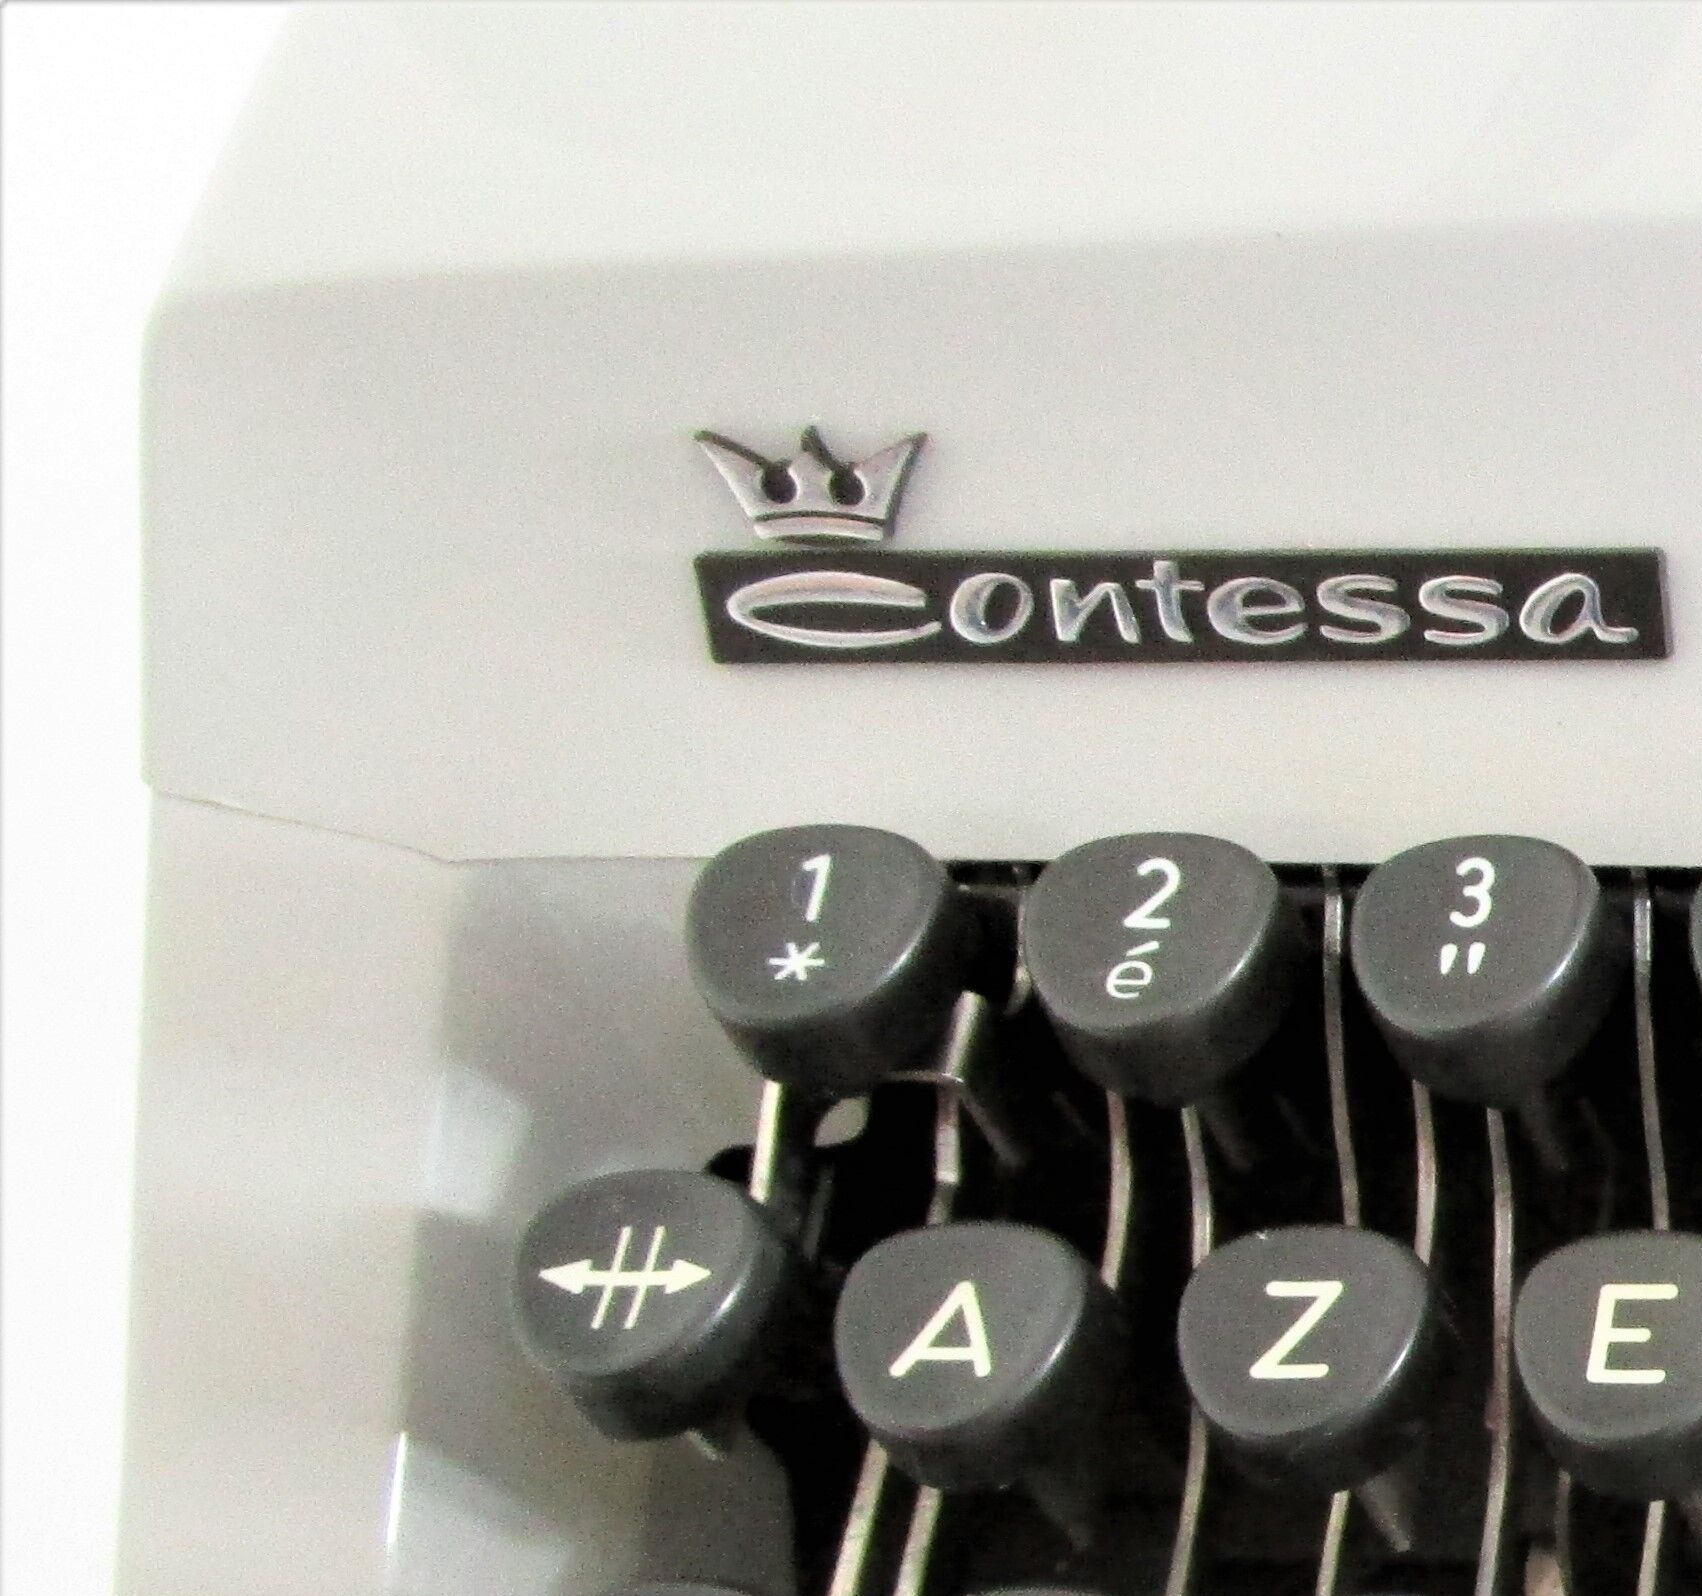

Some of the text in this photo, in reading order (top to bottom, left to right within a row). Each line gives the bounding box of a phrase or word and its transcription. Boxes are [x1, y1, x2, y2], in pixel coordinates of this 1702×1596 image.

[724, 558, 1638, 650] Contessa
[800, 851, 835, 925] 1
[1121, 854, 1183, 923] 2
[1447, 854, 1498, 922] 3
[1104, 938, 1163, 1001] é
[886, 1277, 996, 1380] A
[1247, 1278, 1347, 1382] Z
[1584, 1281, 1681, 1387] E
